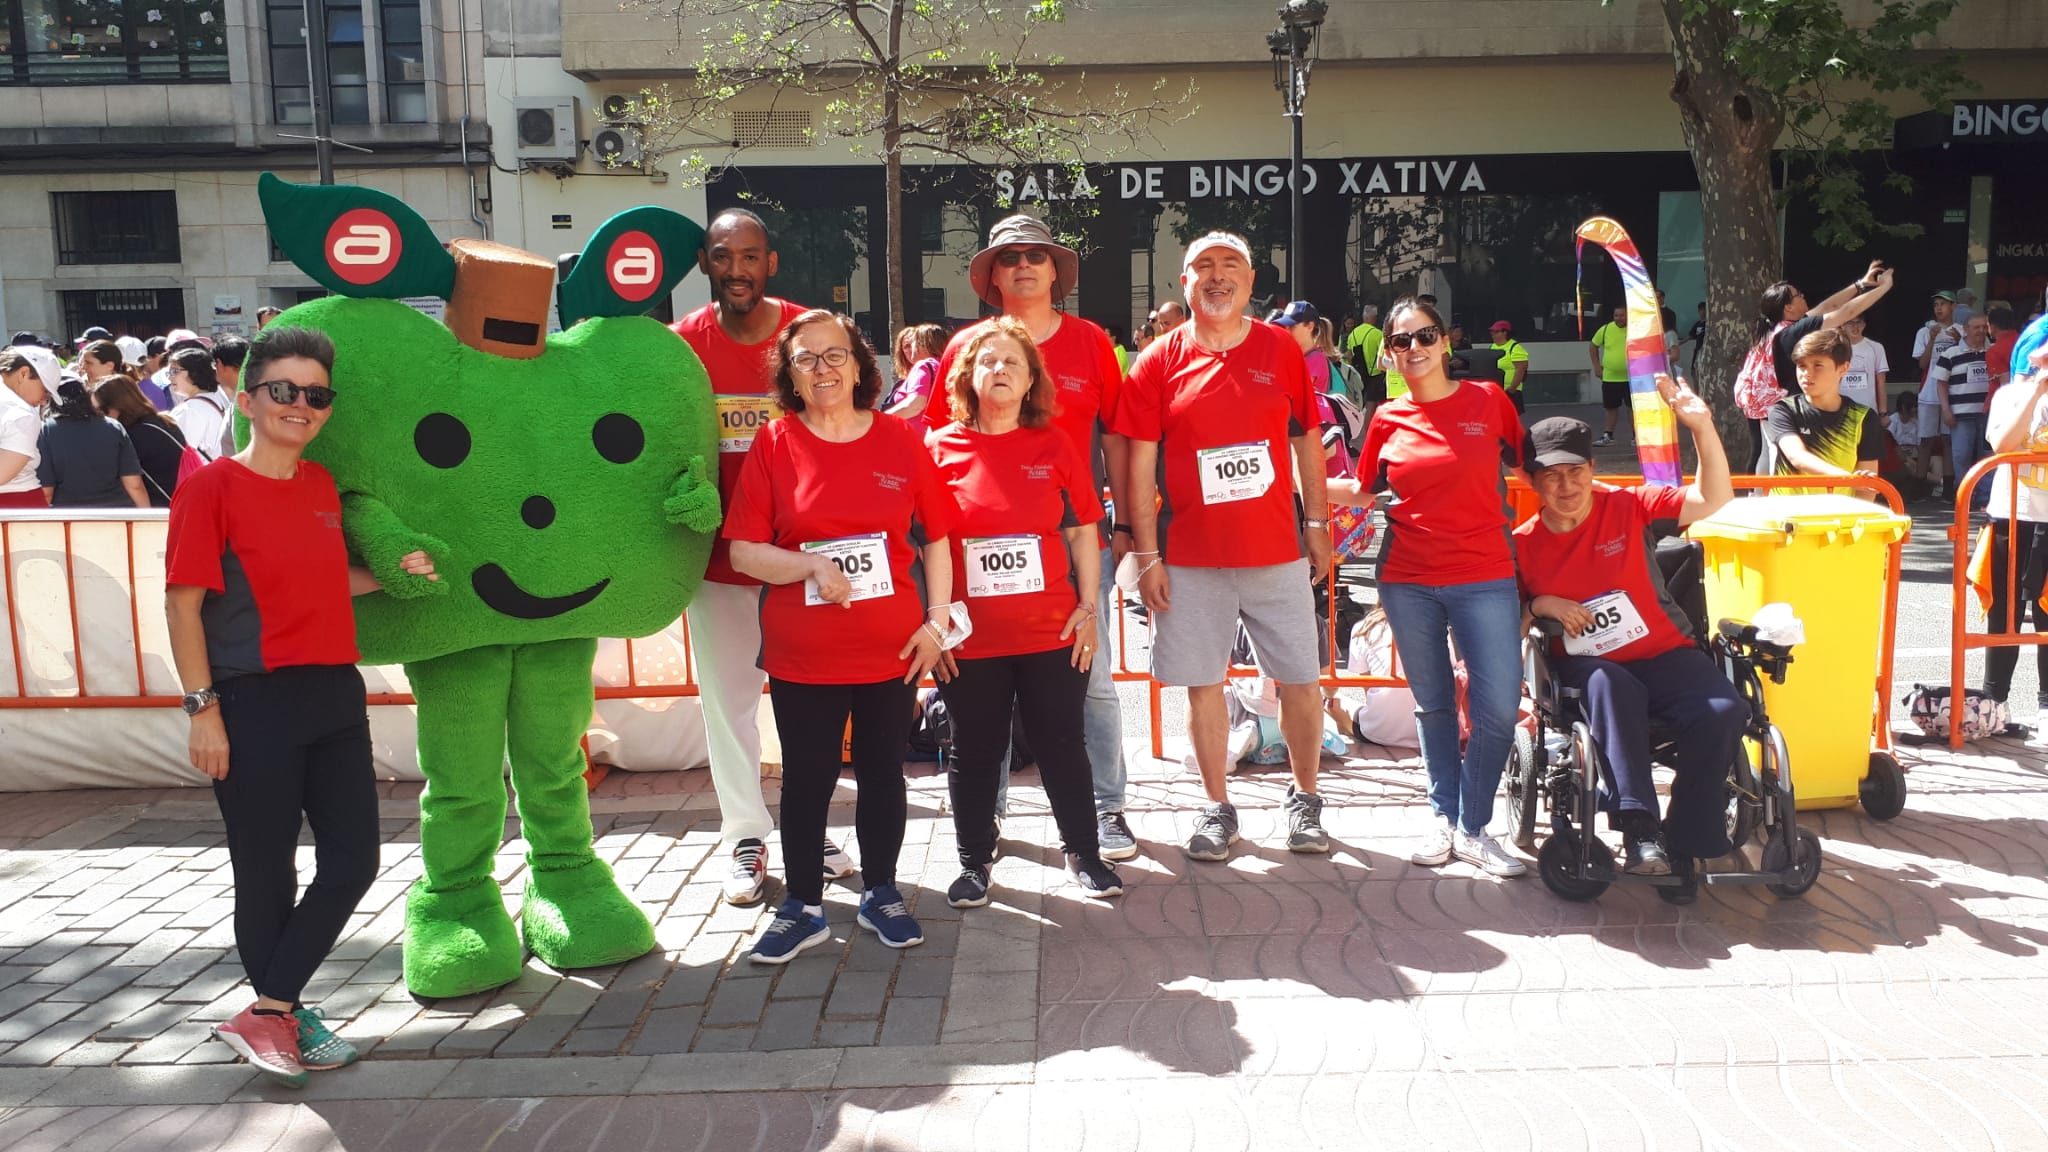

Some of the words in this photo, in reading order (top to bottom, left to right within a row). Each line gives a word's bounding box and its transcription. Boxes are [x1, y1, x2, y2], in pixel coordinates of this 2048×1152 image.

[1952, 104, 2048, 136] BING
[995, 168, 1096, 200] SALA
[1120, 167, 1165, 199] DE
[1190, 163, 1318, 198] BINGO
[1338, 161, 1487, 195] XATIVA
[721, 409, 770, 428] 1005
[1215, 457, 1261, 480] 1005
[831, 552, 873, 575] 005
[979, 550, 1027, 572] 1005
